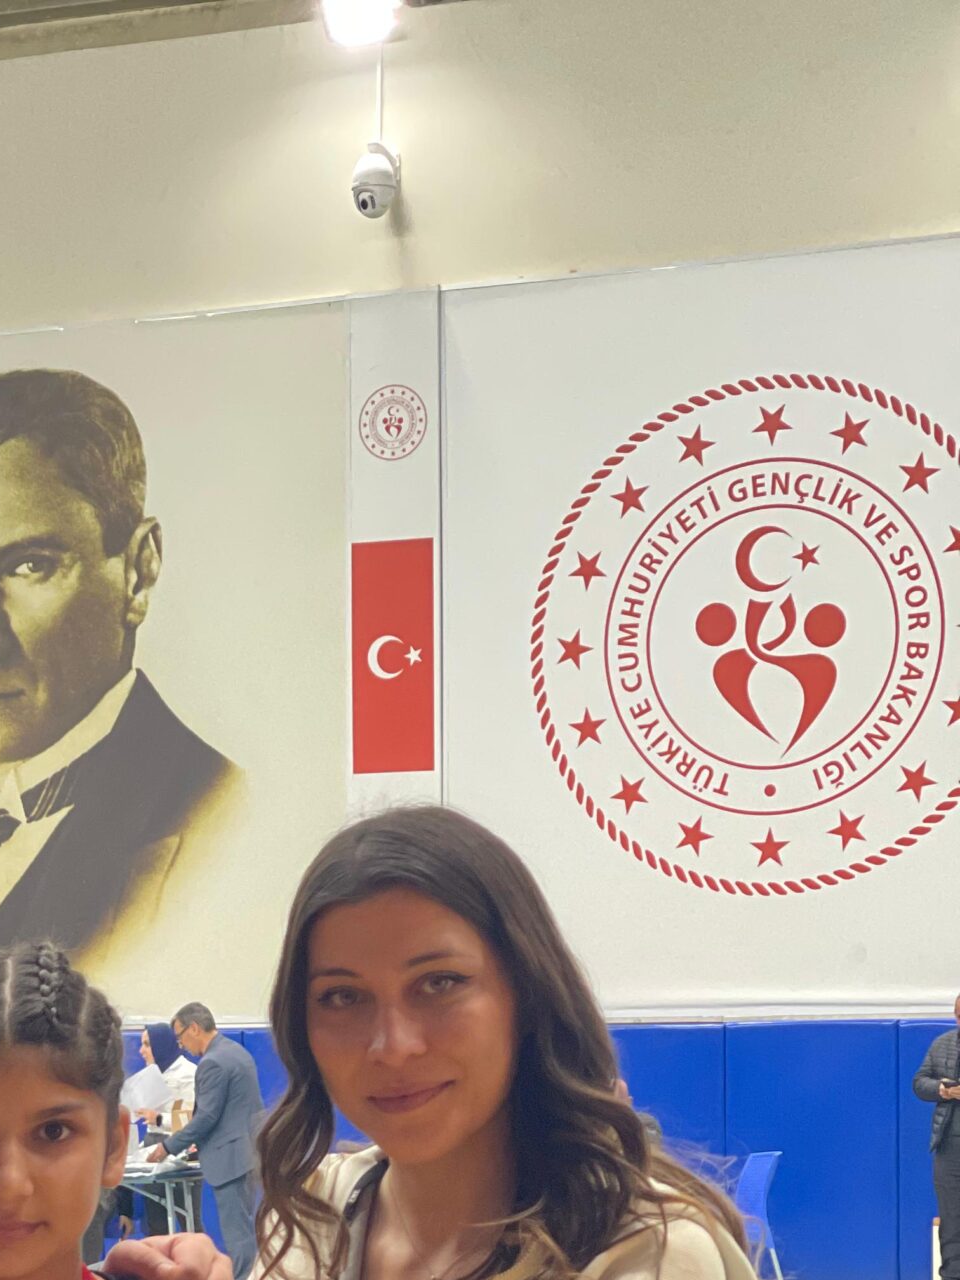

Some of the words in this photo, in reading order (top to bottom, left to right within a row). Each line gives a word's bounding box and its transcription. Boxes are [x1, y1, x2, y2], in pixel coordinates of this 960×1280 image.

[727, 471, 864, 516] GENÇLİK
[862, 503, 900, 547] VE
[616, 485, 721, 693] CUMHURİYETİ
[889, 545, 932, 632] SPOR
[629, 697, 729, 798] TÜRKİYE
[812, 640, 931, 791] BAKANLIĞI
